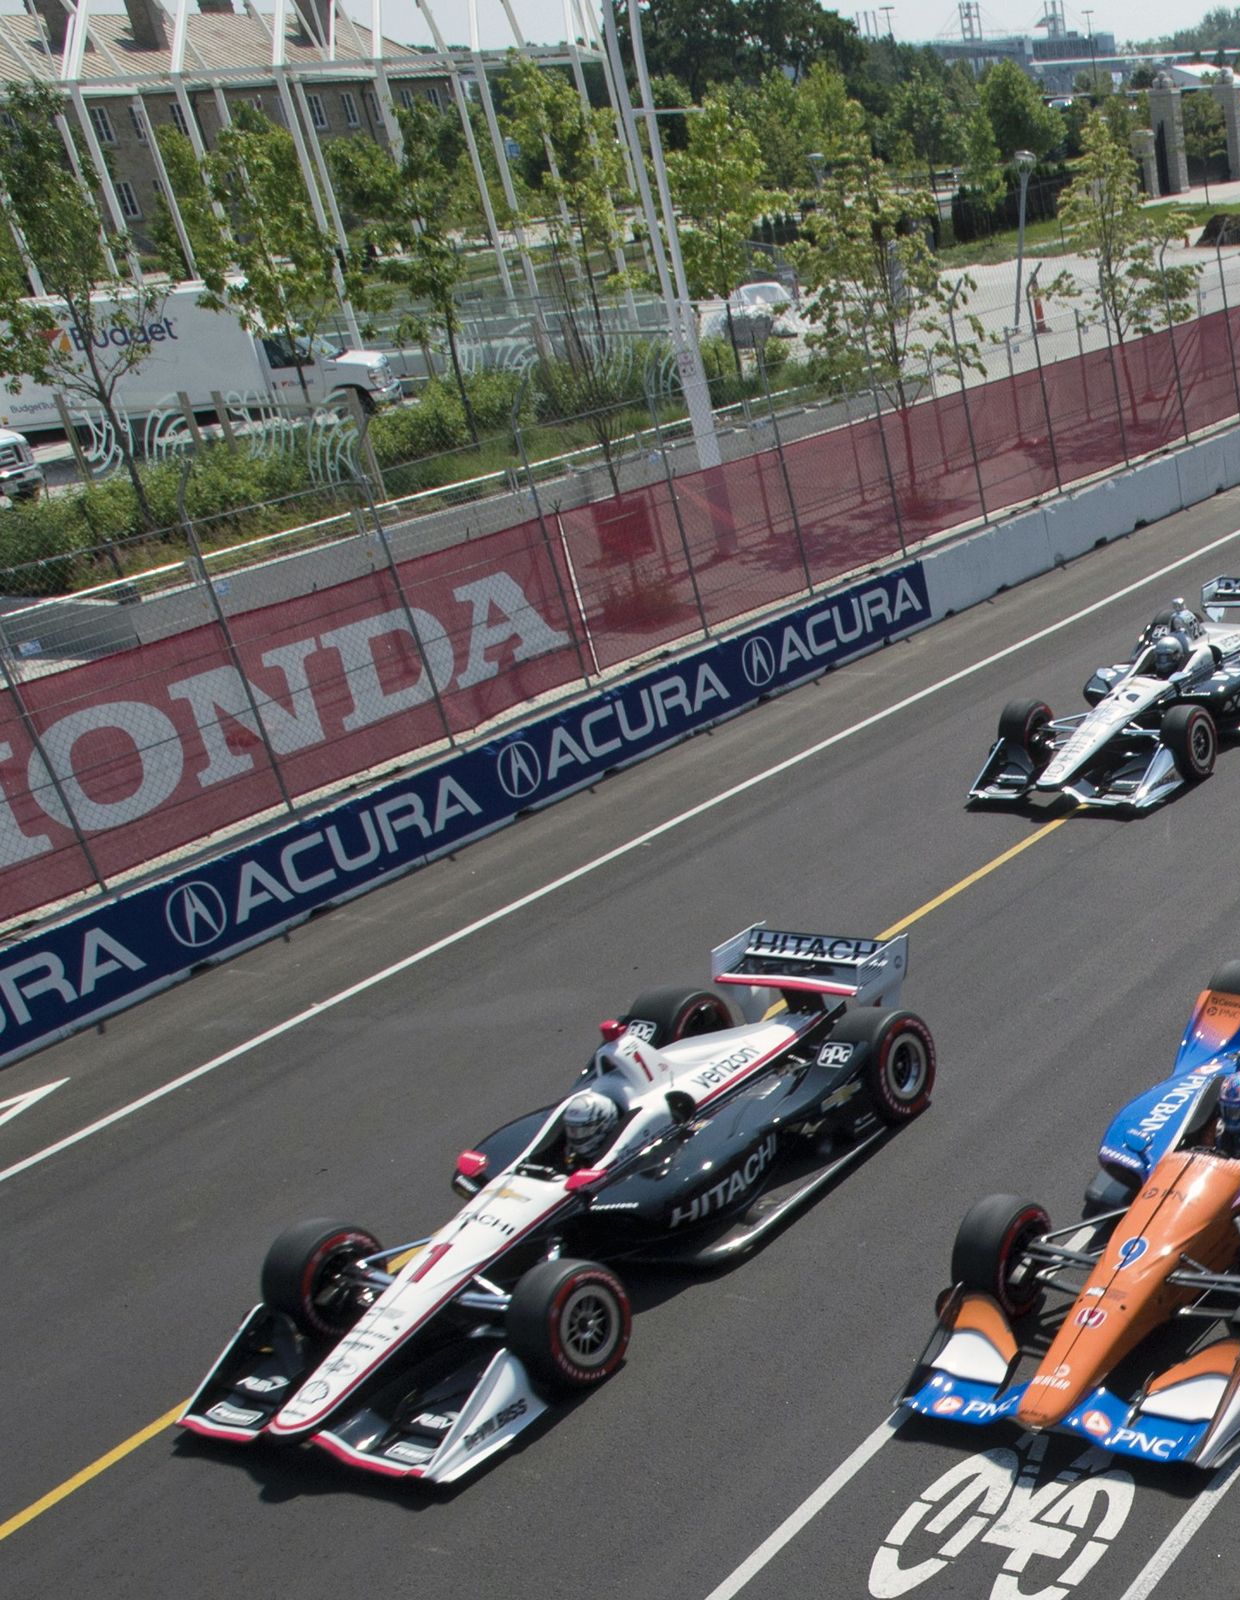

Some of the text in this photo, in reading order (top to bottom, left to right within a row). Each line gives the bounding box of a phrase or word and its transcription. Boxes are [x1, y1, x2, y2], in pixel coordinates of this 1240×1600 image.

[779, 578, 923, 673] ACURA
[547, 663, 731, 780] ACURA
[236, 777, 482, 924] ACURA
[0, 927, 147, 1034] RA
[628, 1021, 655, 1042] PPG
[633, 1051, 654, 1082] 1
[691, 1046, 761, 1089] verizon
[819, 1045, 851, 1065] PPG
[670, 1132, 778, 1228] HITACHI
[408, 1244, 454, 1283] 1
[1112, 1235, 1149, 1270] 9
[1111, 1428, 1179, 1459] PNC
